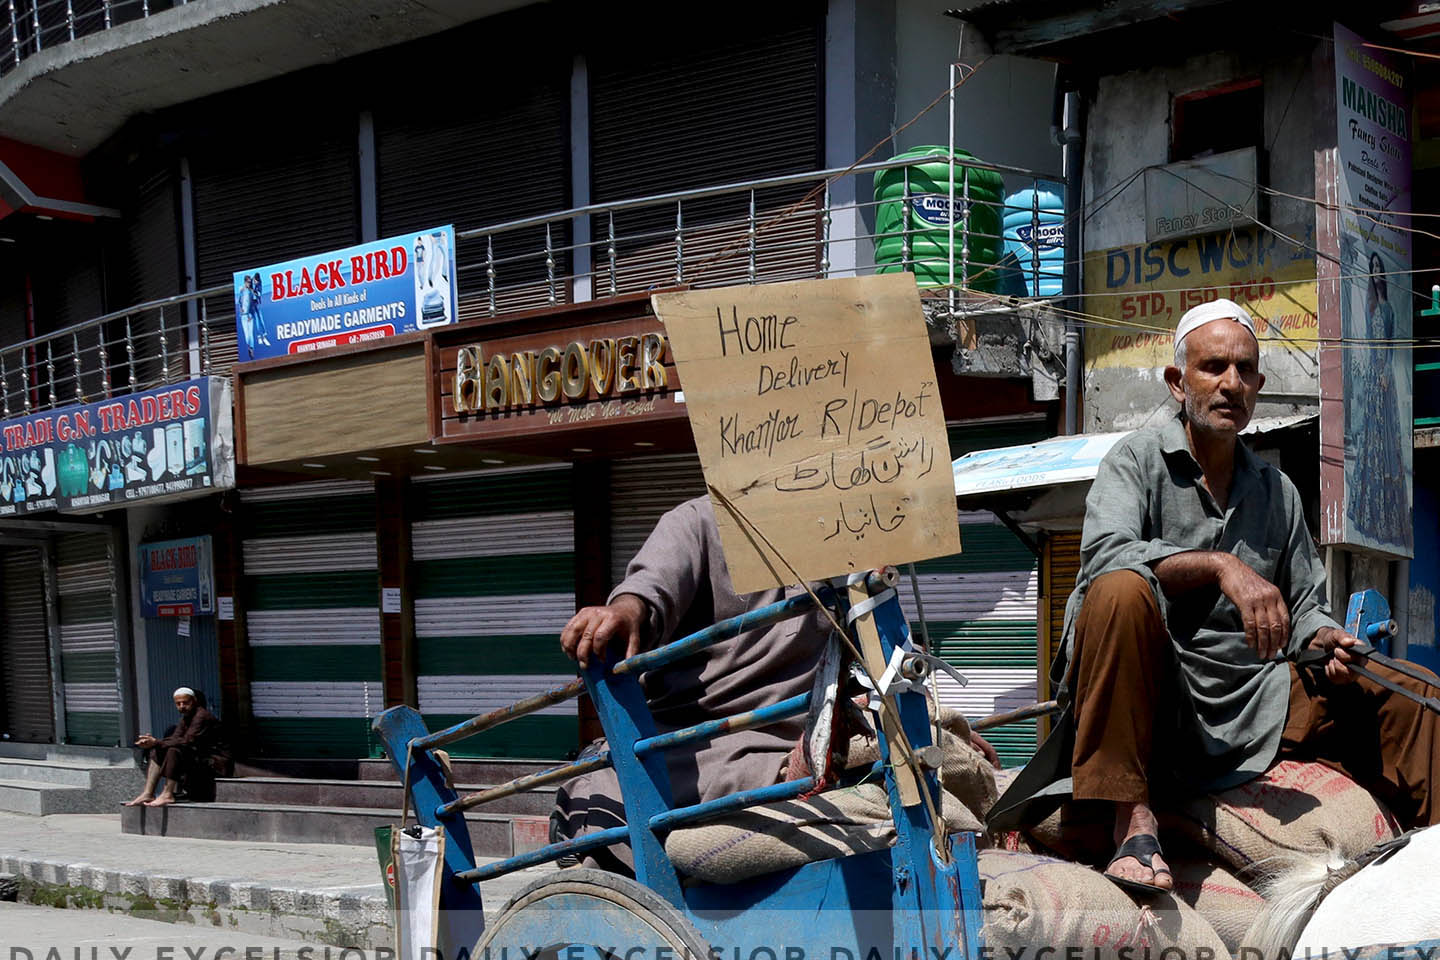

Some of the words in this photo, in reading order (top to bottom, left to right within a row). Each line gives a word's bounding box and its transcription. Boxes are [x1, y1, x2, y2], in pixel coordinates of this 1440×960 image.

[1342, 75, 1408, 141] MANSHA
[1032, 227, 1064, 237] OON
[1155, 213, 1198, 233] Fancy
[270, 259, 345, 301] BLACK
[349, 245, 408, 285] BIRD
[1106, 242, 1191, 288] DISC
[276, 313, 342, 340] READYMADE
[343, 301, 406, 328] GARMENTS
[310, 297, 327, 312] Deals
[334, 293, 343, 307] All
[343, 291, 359, 306] Kinds
[359, 288, 367, 303] of
[1121, 291, 1173, 321] STD,
[716, 305, 799, 357] Home
[454, 332, 668, 413] HANGOVER
[757, 350, 850, 396] Delivery
[56, 409, 97, 443] G.N.
[97, 385, 201, 433] TRADERS
[548, 411, 564, 425] We
